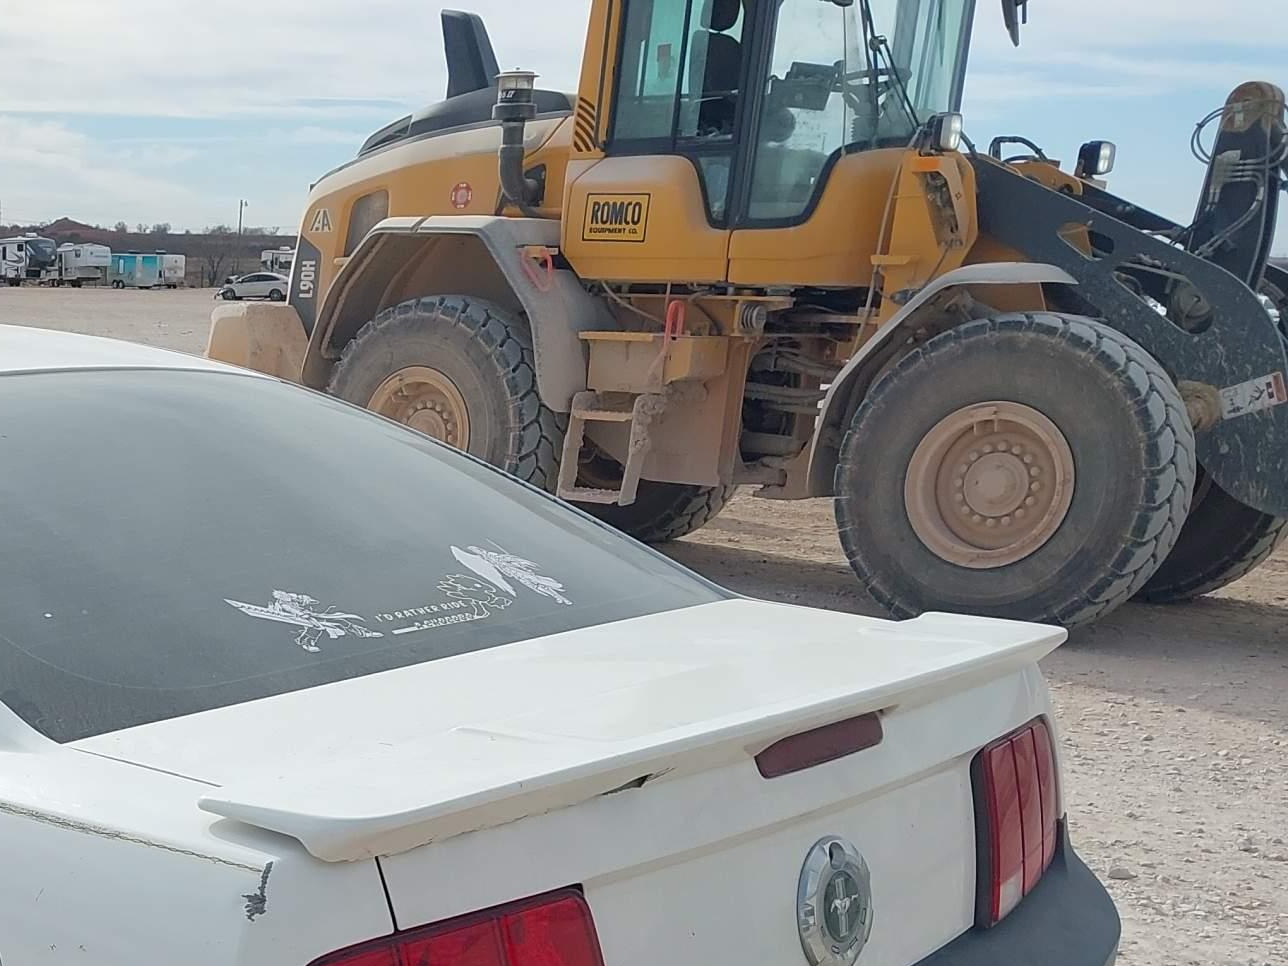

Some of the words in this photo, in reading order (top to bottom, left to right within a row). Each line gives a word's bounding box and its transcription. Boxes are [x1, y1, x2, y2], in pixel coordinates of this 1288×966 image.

[590, 201, 643, 226] ROMCO
[298, 260, 317, 298] L90H
[375, 614, 393, 622] I'D
[394, 605, 439, 619] RATHER
[440, 600, 467, 611] RIDE
